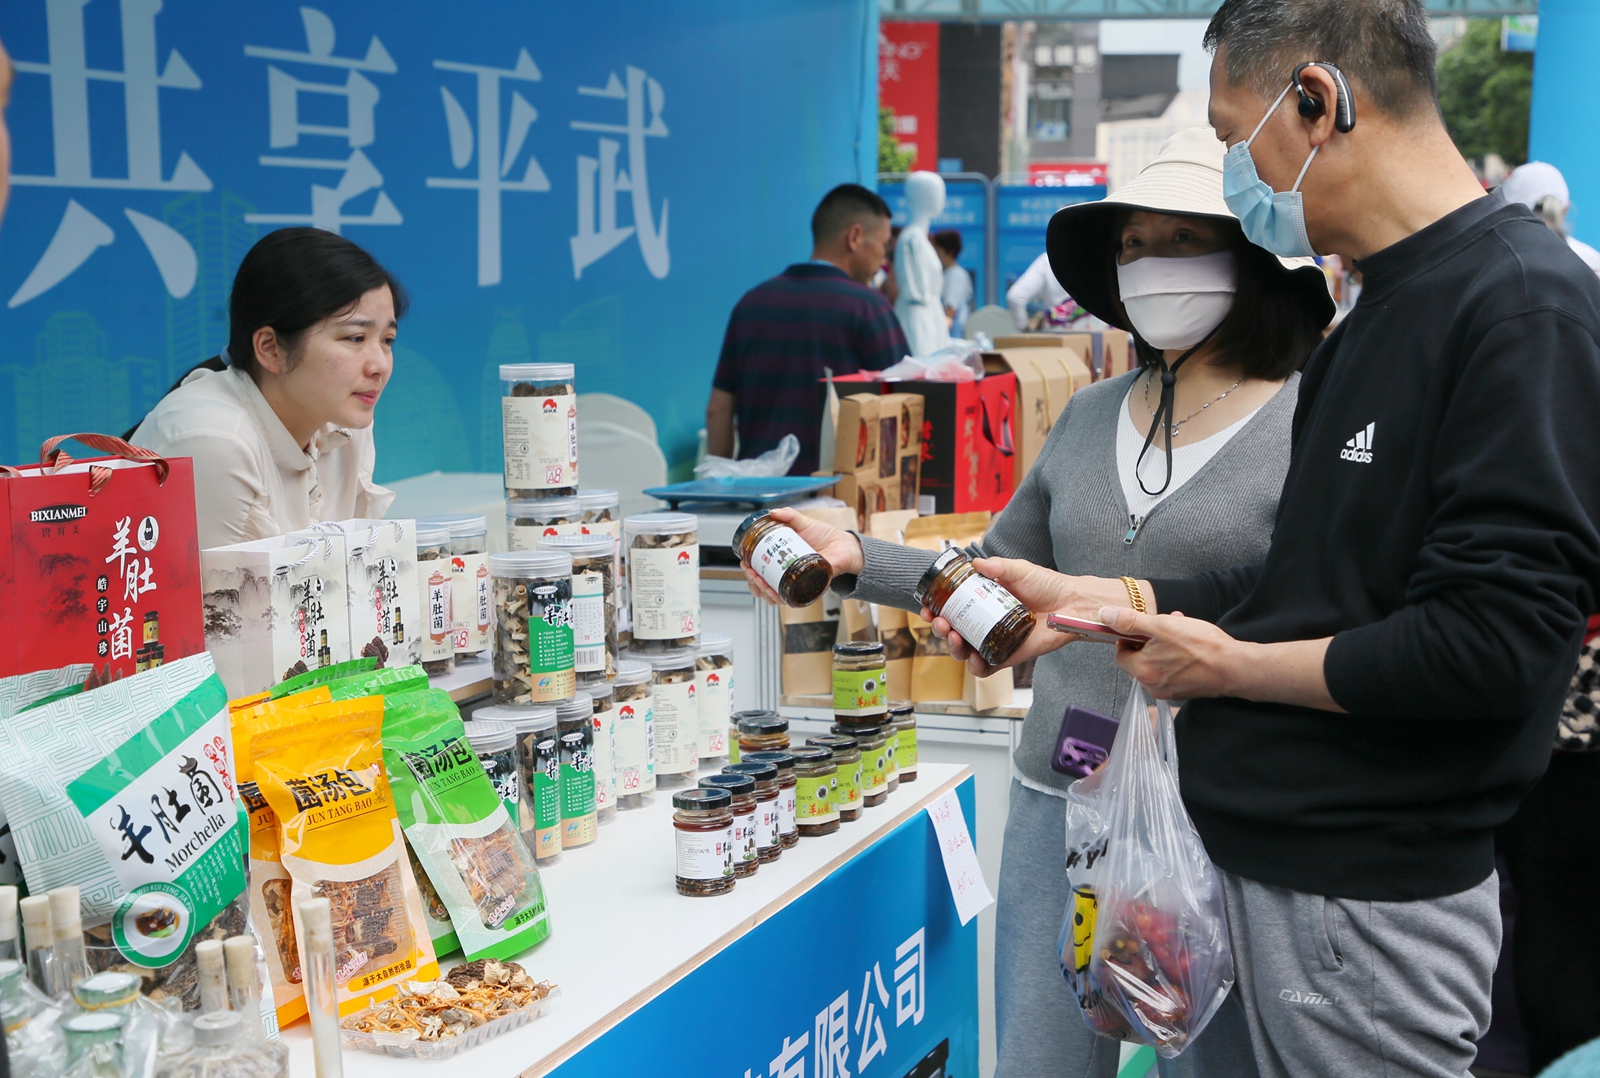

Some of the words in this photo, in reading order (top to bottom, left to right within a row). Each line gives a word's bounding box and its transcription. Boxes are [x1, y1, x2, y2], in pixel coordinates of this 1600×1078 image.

[5, 0, 670, 310] 共享平武
[1340, 446, 1373, 464] adidas
[29, 506, 86, 522] BIXIANMEI
[105, 515, 157, 661] 羊肚菌
[378, 559, 399, 634] 羊肚菌
[431, 588, 444, 629] 羊肚菌
[478, 581, 487, 620] 羊肚菌
[301, 578, 325, 658] 羊肚菌
[402, 736, 473, 785] 菌汤包
[440, 773, 461, 787] TANG
[460, 766, 476, 779] BAO
[110, 754, 223, 865] 羊肚菌
[284, 768, 372, 813] 菌汤包
[307, 811, 326, 826] JUN
[327, 803, 353, 819] TANG
[354, 798, 372, 812] BAO
[162, 811, 227, 873] Morchella
[150, 884, 162, 892] KUI
[161, 884, 179, 897] ZENG
[178, 892, 189, 904] JIA
[362, 959, 412, 987] 源于大自然的珍品
[742, 926, 926, 1078] 有限公司
